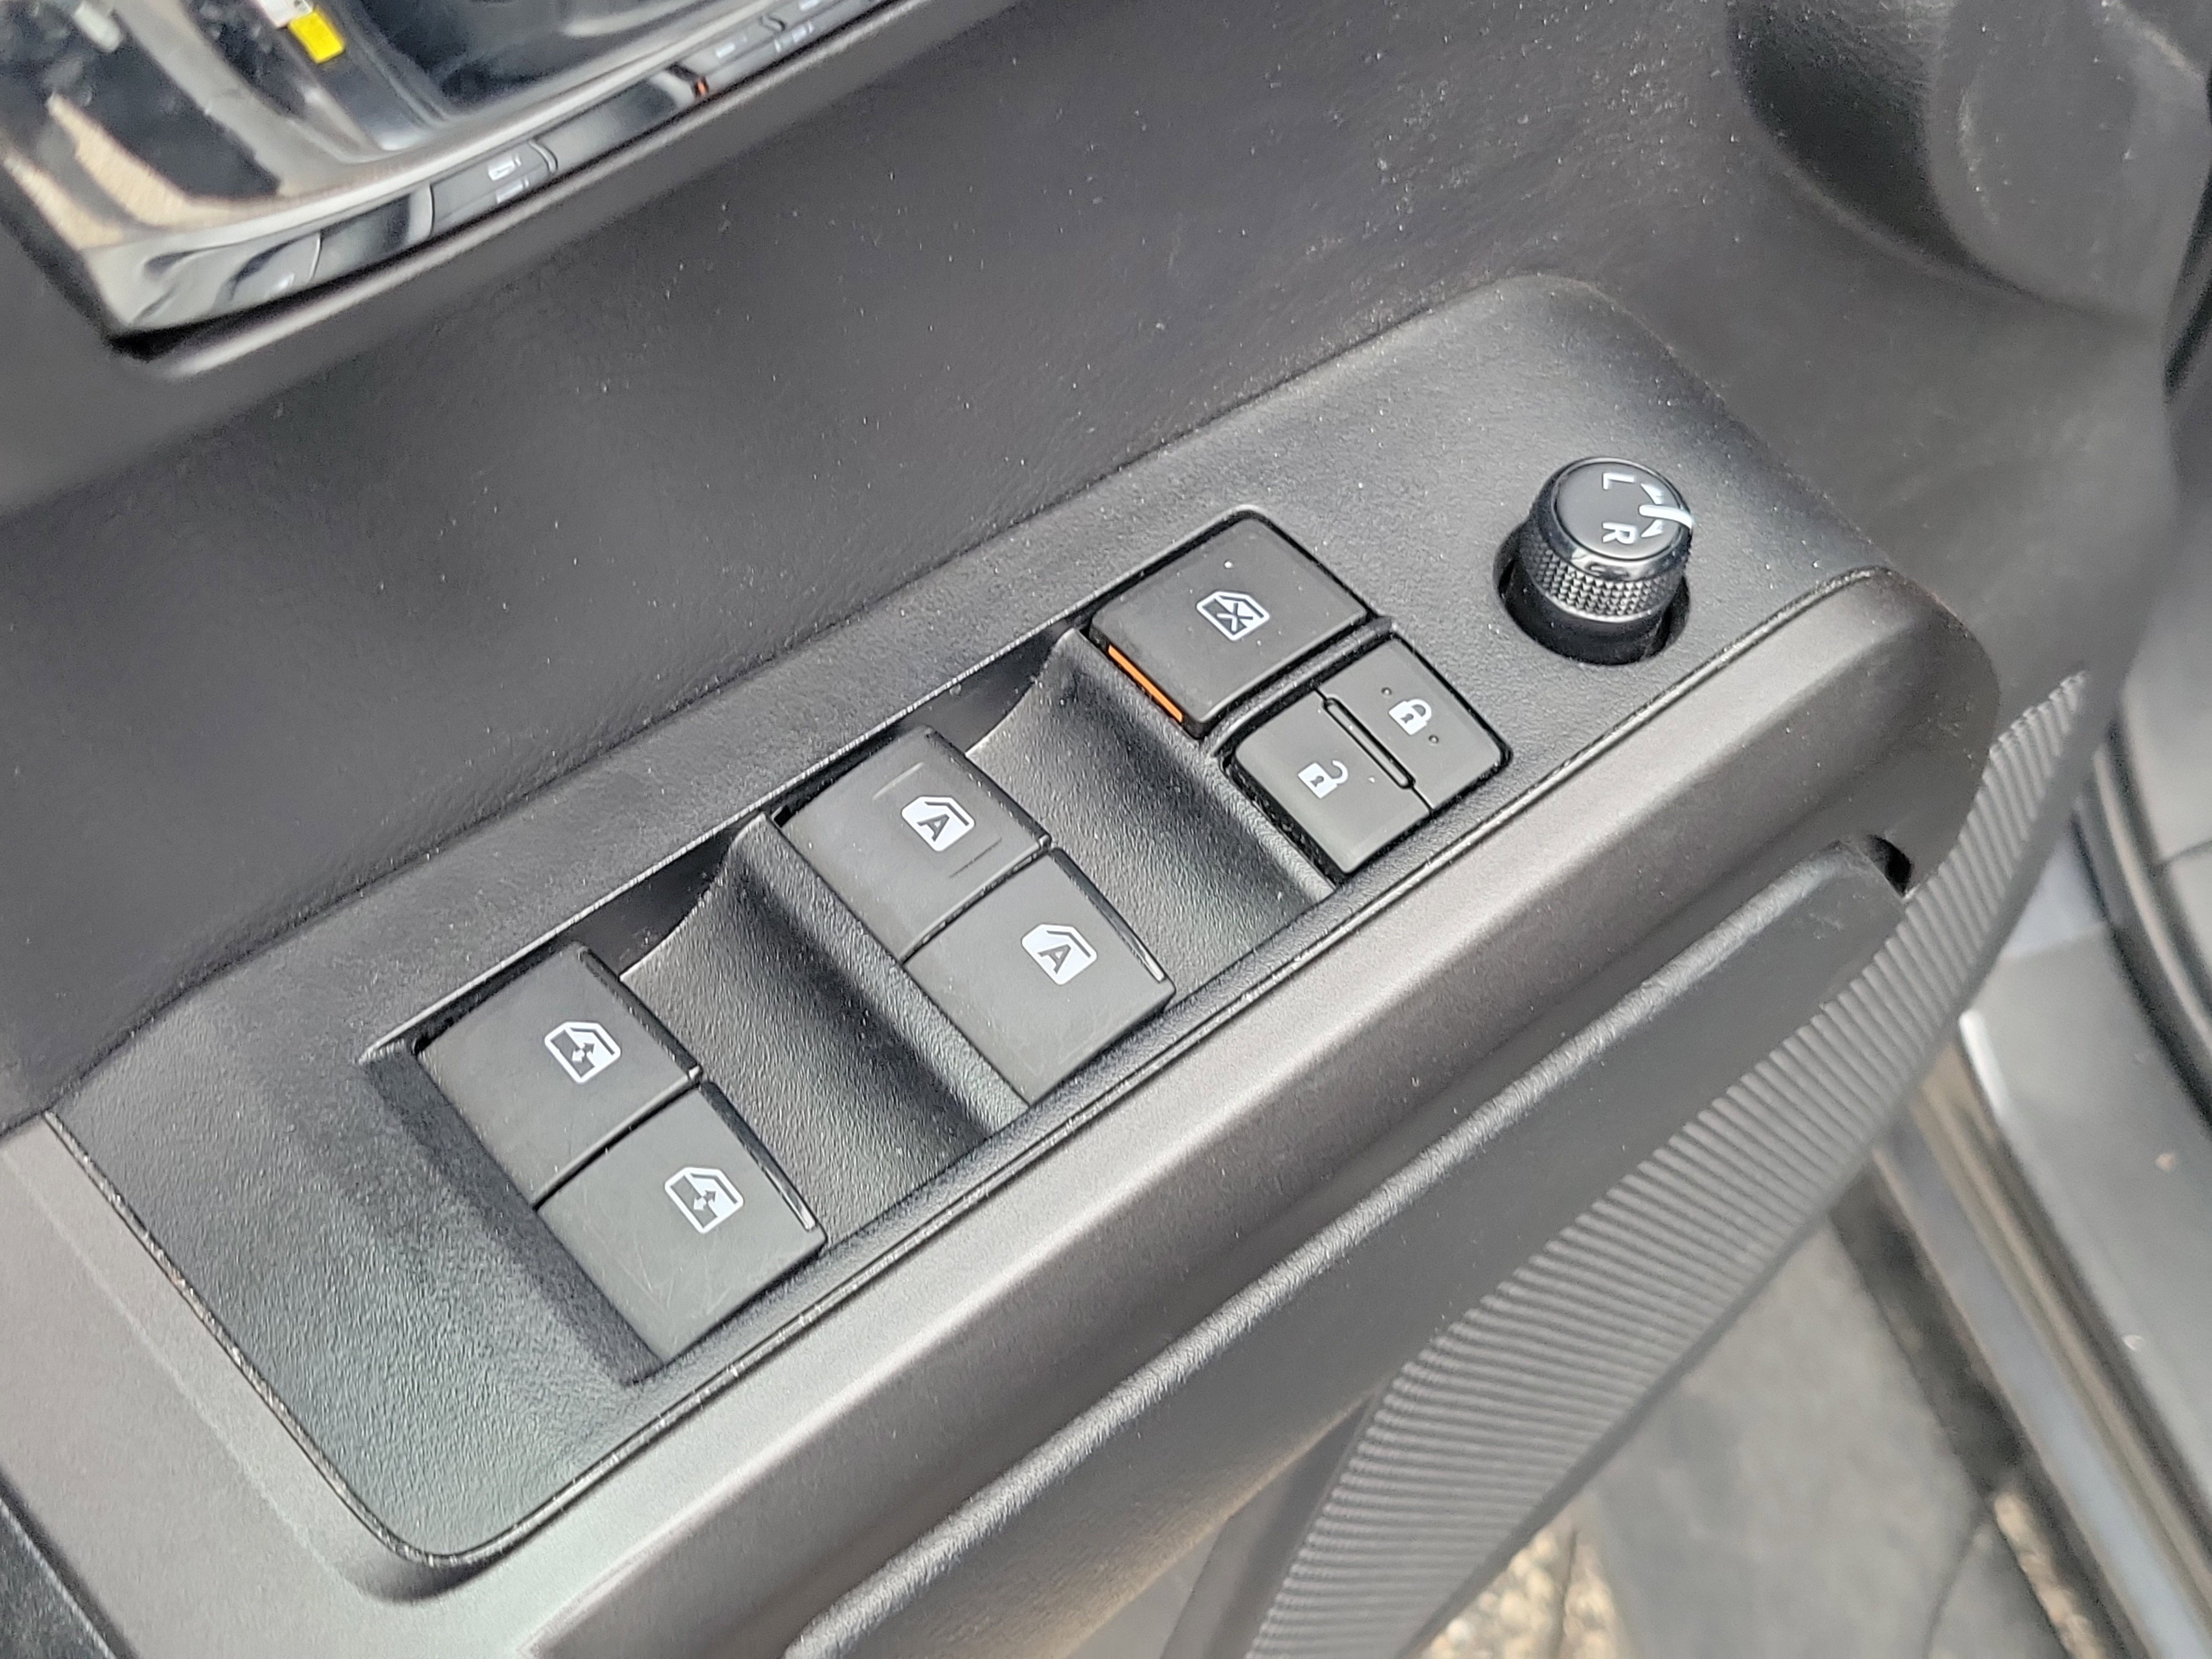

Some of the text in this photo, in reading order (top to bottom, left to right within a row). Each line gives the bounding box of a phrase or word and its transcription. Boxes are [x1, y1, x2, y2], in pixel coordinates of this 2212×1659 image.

[1602, 472, 1634, 490] L
[1602, 522, 1636, 545] R
[916, 813, 950, 842] A
[1037, 943, 1071, 974] A
